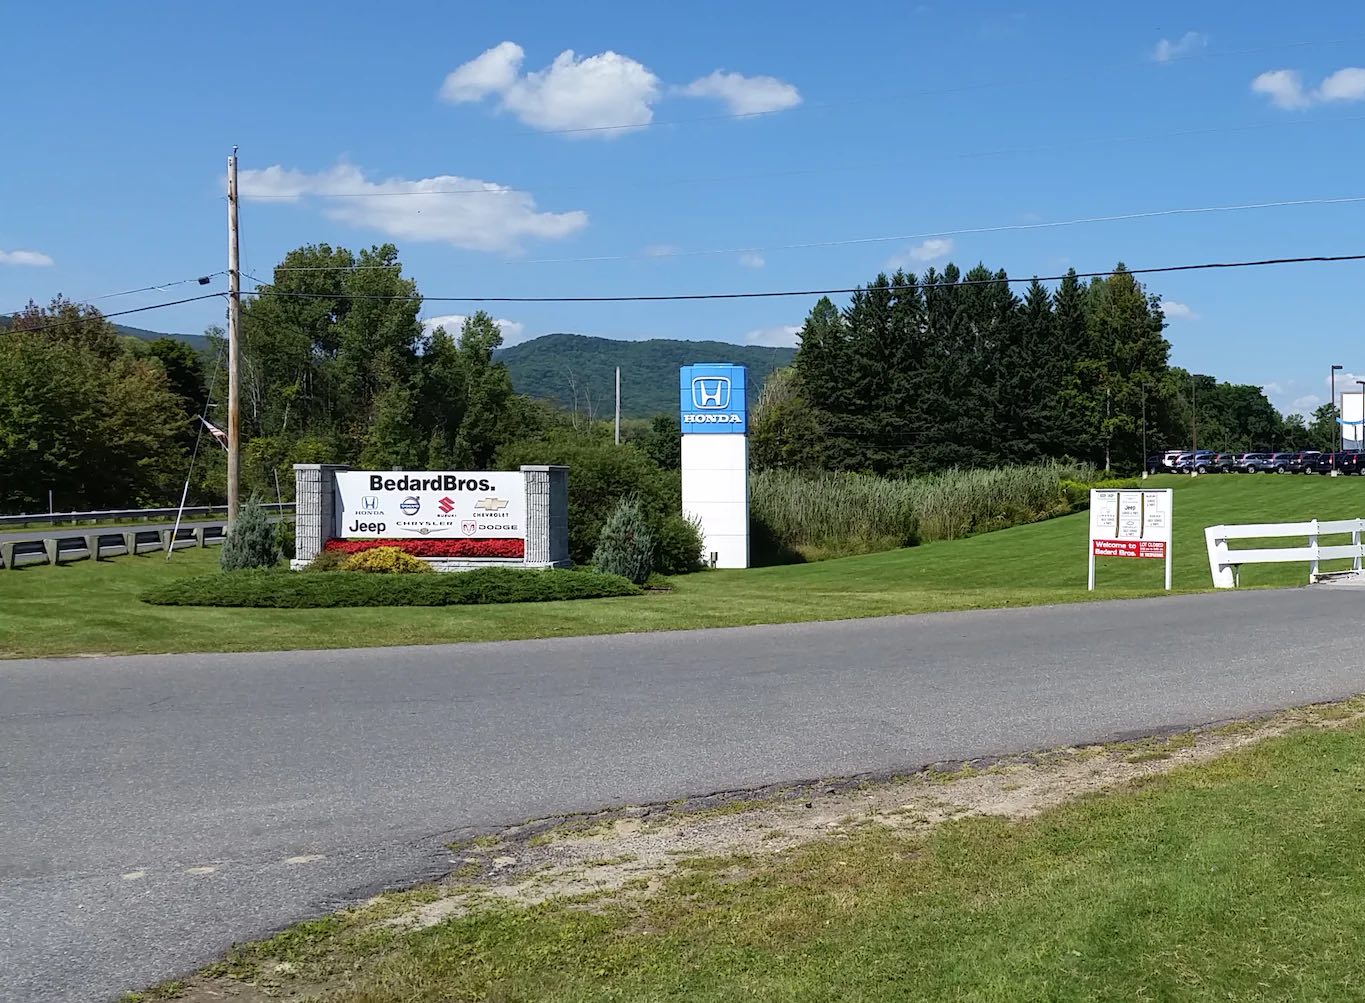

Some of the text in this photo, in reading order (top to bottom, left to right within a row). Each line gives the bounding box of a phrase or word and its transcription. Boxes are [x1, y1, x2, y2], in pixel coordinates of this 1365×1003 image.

[684, 414, 743, 423] HONDA
[349, 520, 386, 534] Jeep
[1095, 541, 1127, 549] Welcome
